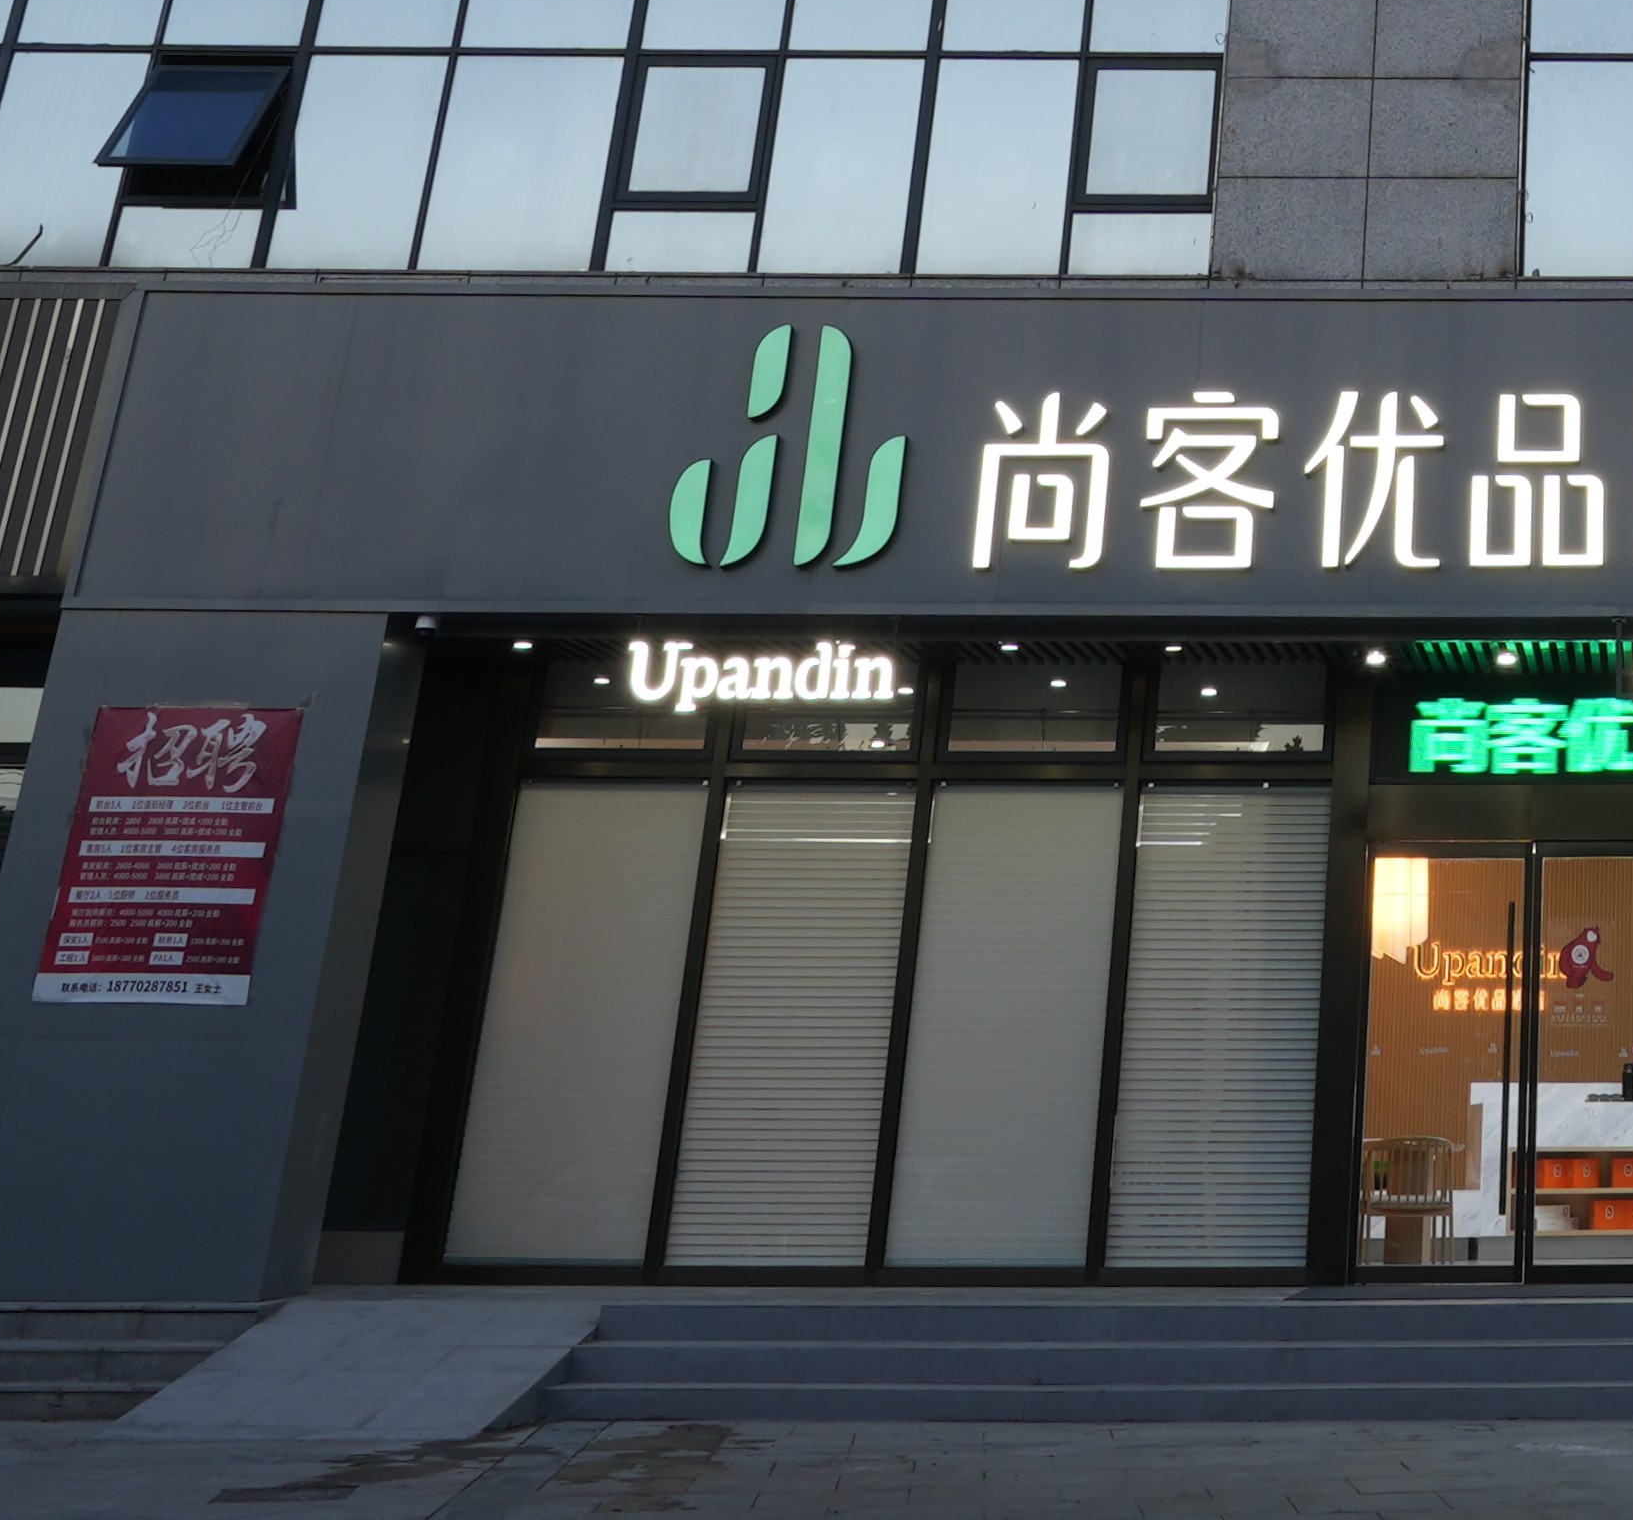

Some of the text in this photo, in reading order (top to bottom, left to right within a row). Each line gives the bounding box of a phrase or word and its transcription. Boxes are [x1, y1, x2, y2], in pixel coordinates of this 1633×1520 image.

[627, 639, 895, 715] Upandin
[117, 711, 268, 793] 招聘
[61, 980, 222, 994] 联系电话： 18770287851 王女士
